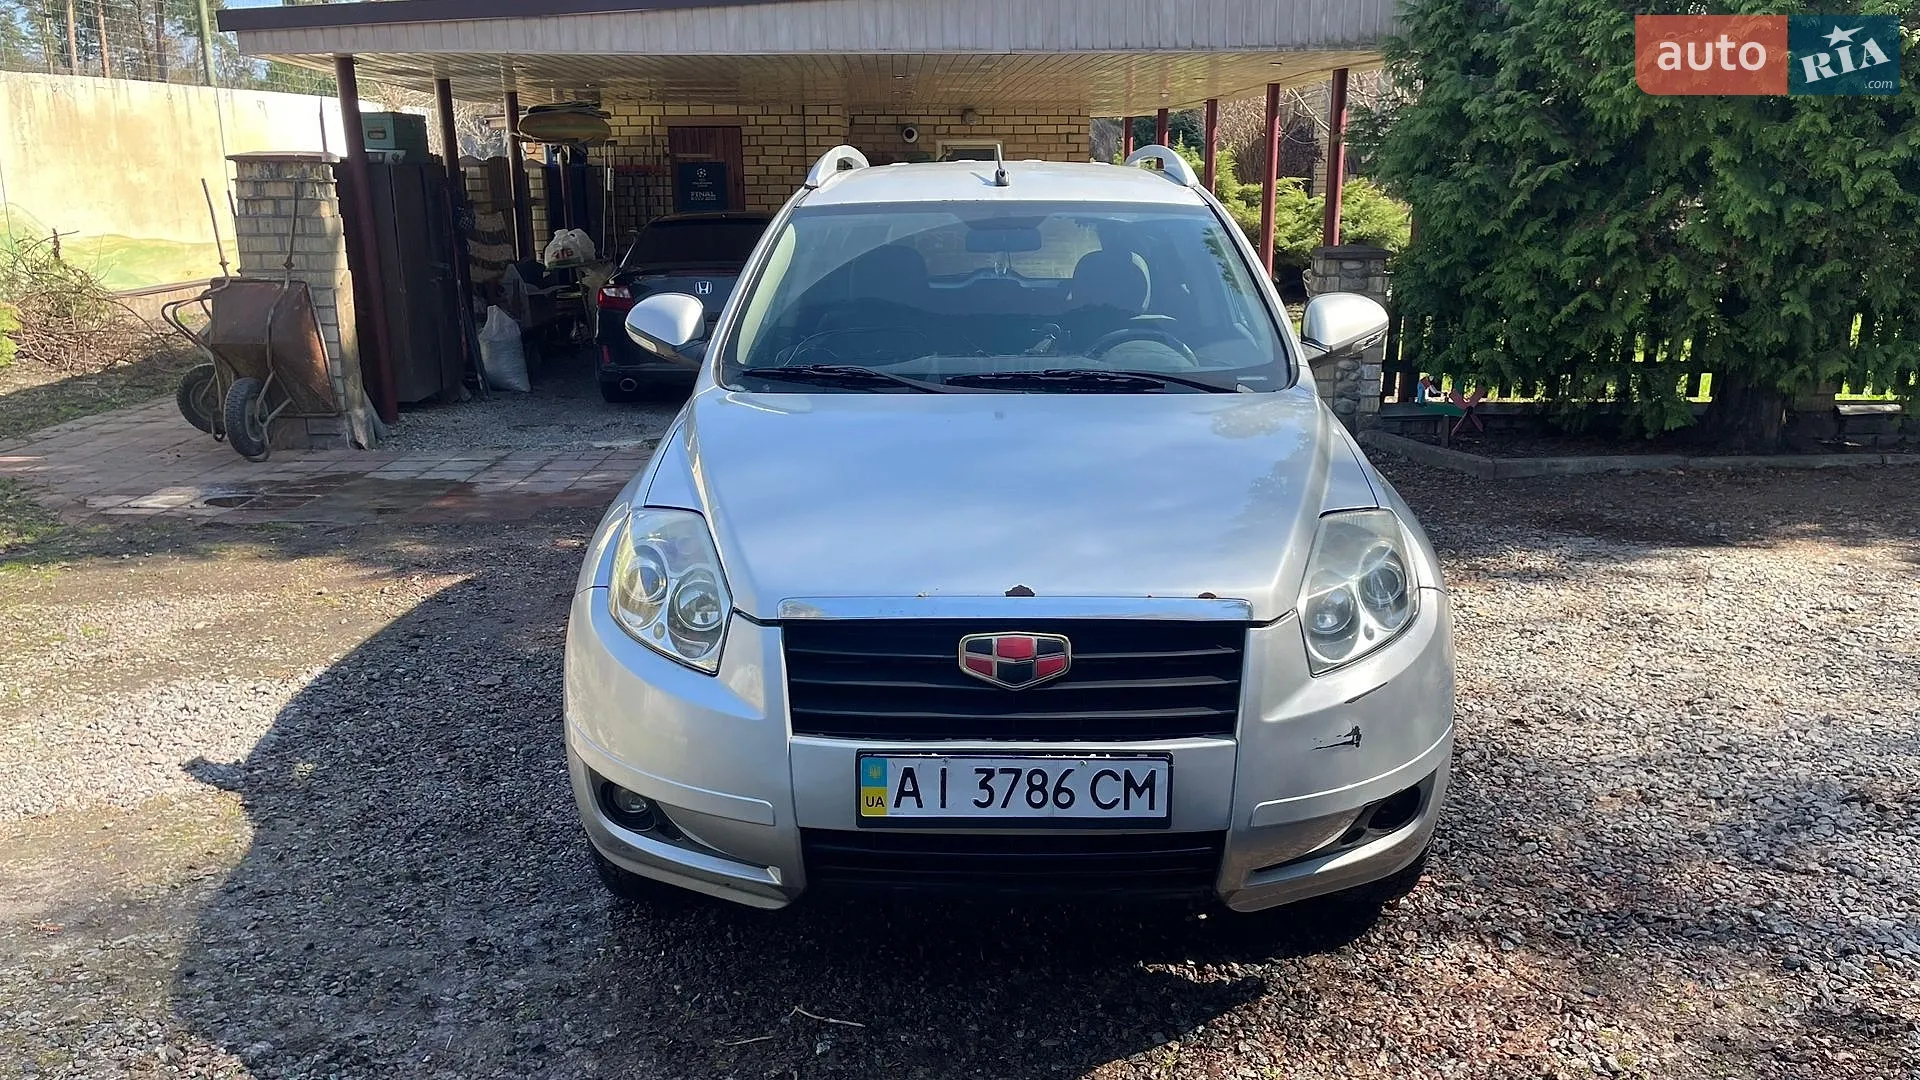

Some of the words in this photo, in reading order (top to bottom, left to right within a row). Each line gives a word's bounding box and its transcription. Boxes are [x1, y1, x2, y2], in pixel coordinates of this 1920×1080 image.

[865, 795, 885, 808] UA
[972, 767, 1076, 810] 3786
[1090, 768, 1157, 811] CM
